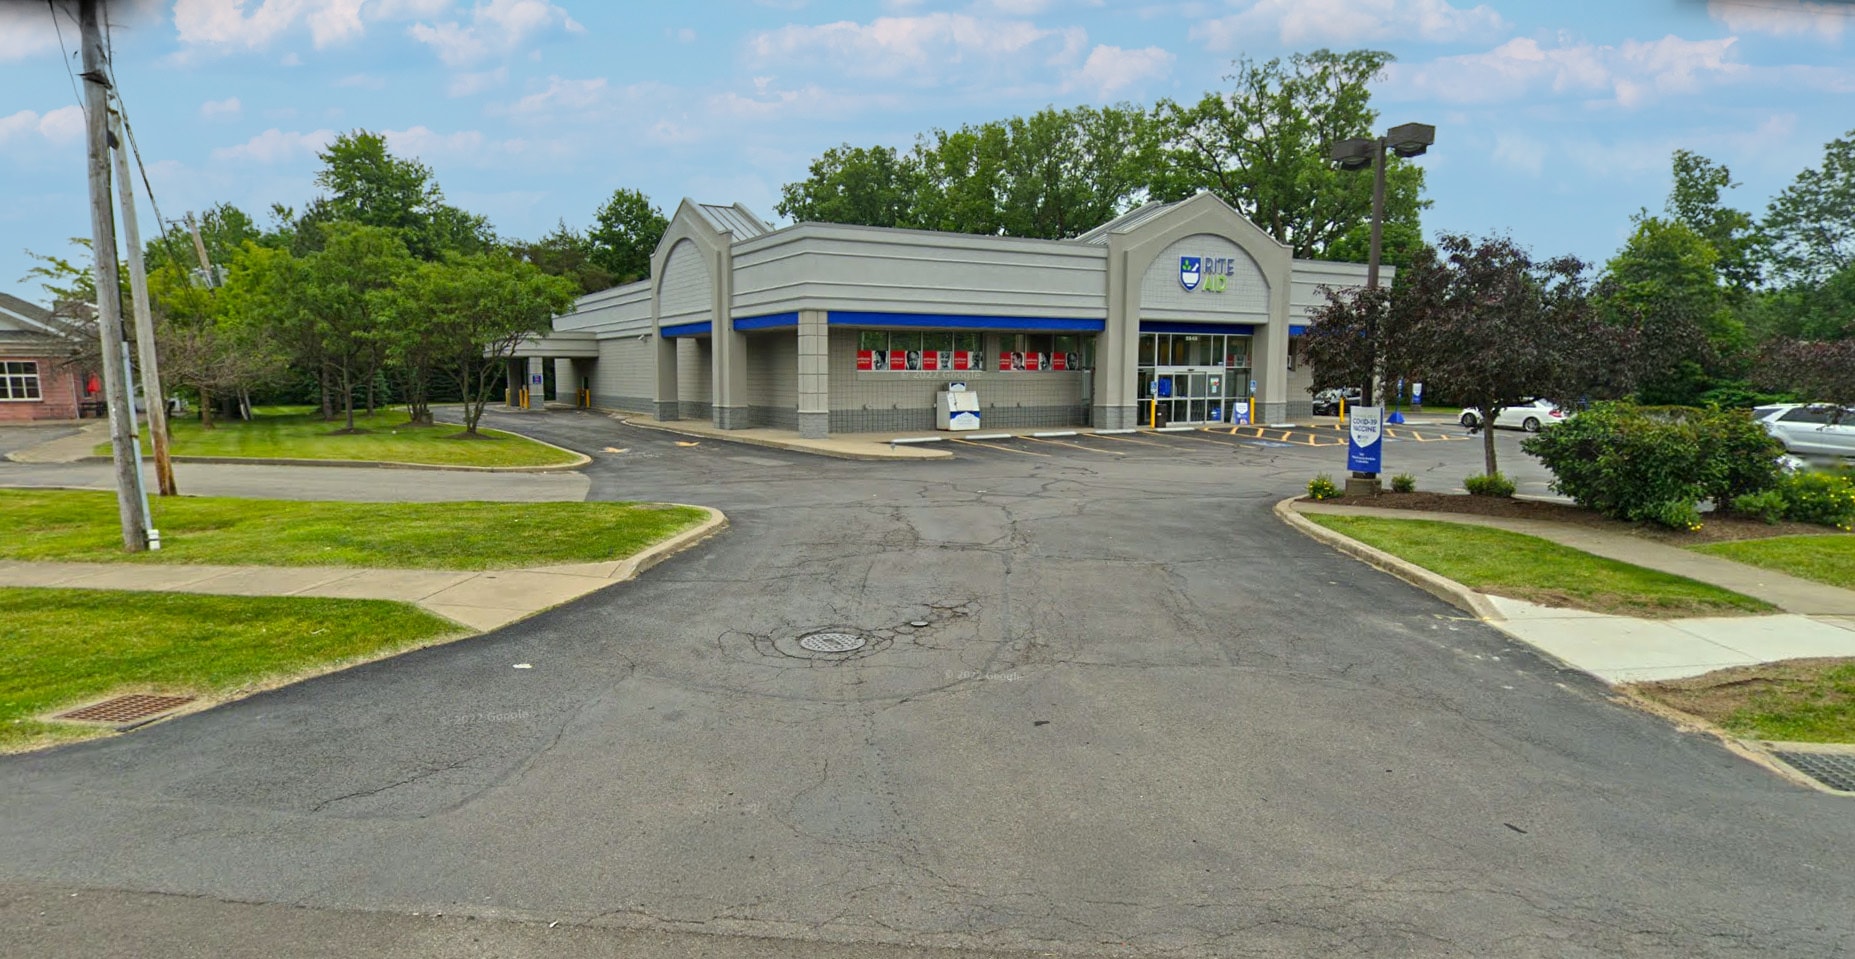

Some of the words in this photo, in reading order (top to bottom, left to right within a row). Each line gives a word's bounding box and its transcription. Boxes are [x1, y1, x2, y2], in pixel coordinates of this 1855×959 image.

[1204, 257, 1235, 276] RITE
[1202, 274, 1228, 293] AID
[1353, 417, 1377, 426] COVID-19
